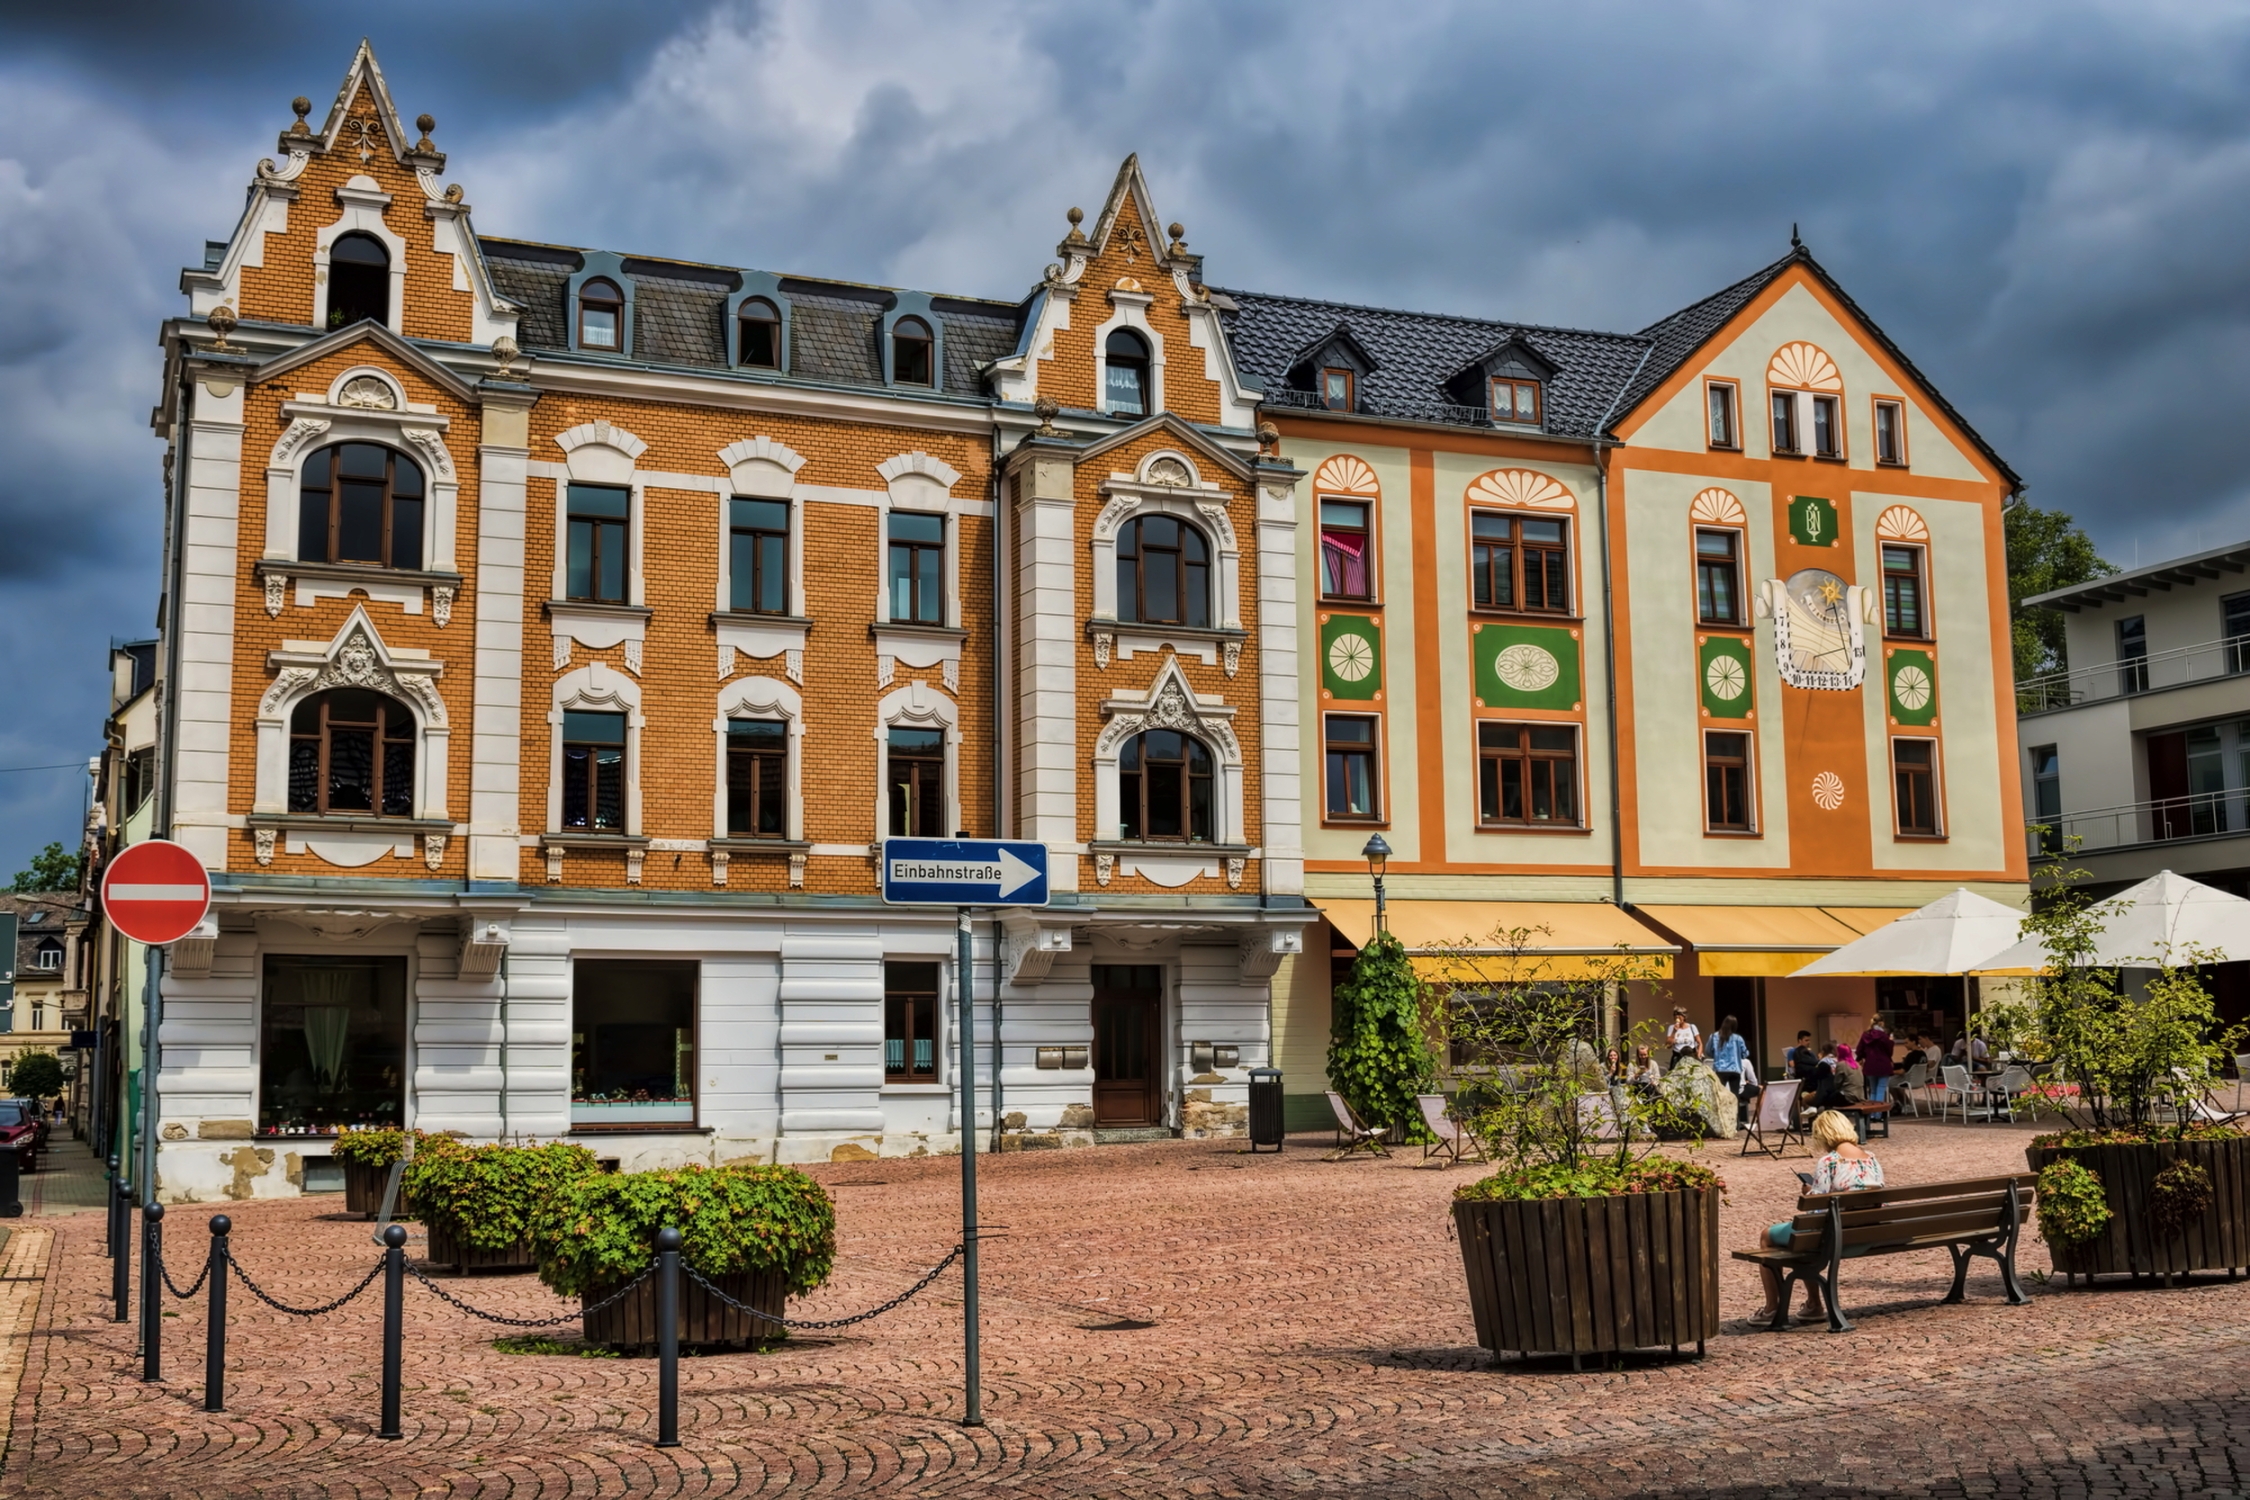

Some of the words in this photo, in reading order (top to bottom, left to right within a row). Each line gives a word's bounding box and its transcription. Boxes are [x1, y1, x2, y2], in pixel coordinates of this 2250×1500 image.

[1779, 616, 1785, 627] 7
[1780, 639, 1786, 649] 8
[1853, 647, 1863, 658] 15
[1783, 662, 1790, 673] 9
[1791, 674, 1801, 685] 10
[1805, 675, 1814, 686] 11
[1817, 676, 1827, 686] 12
[1829, 676, 1840, 687] 13
[894, 864, 1002, 880] Einbahnstraße
